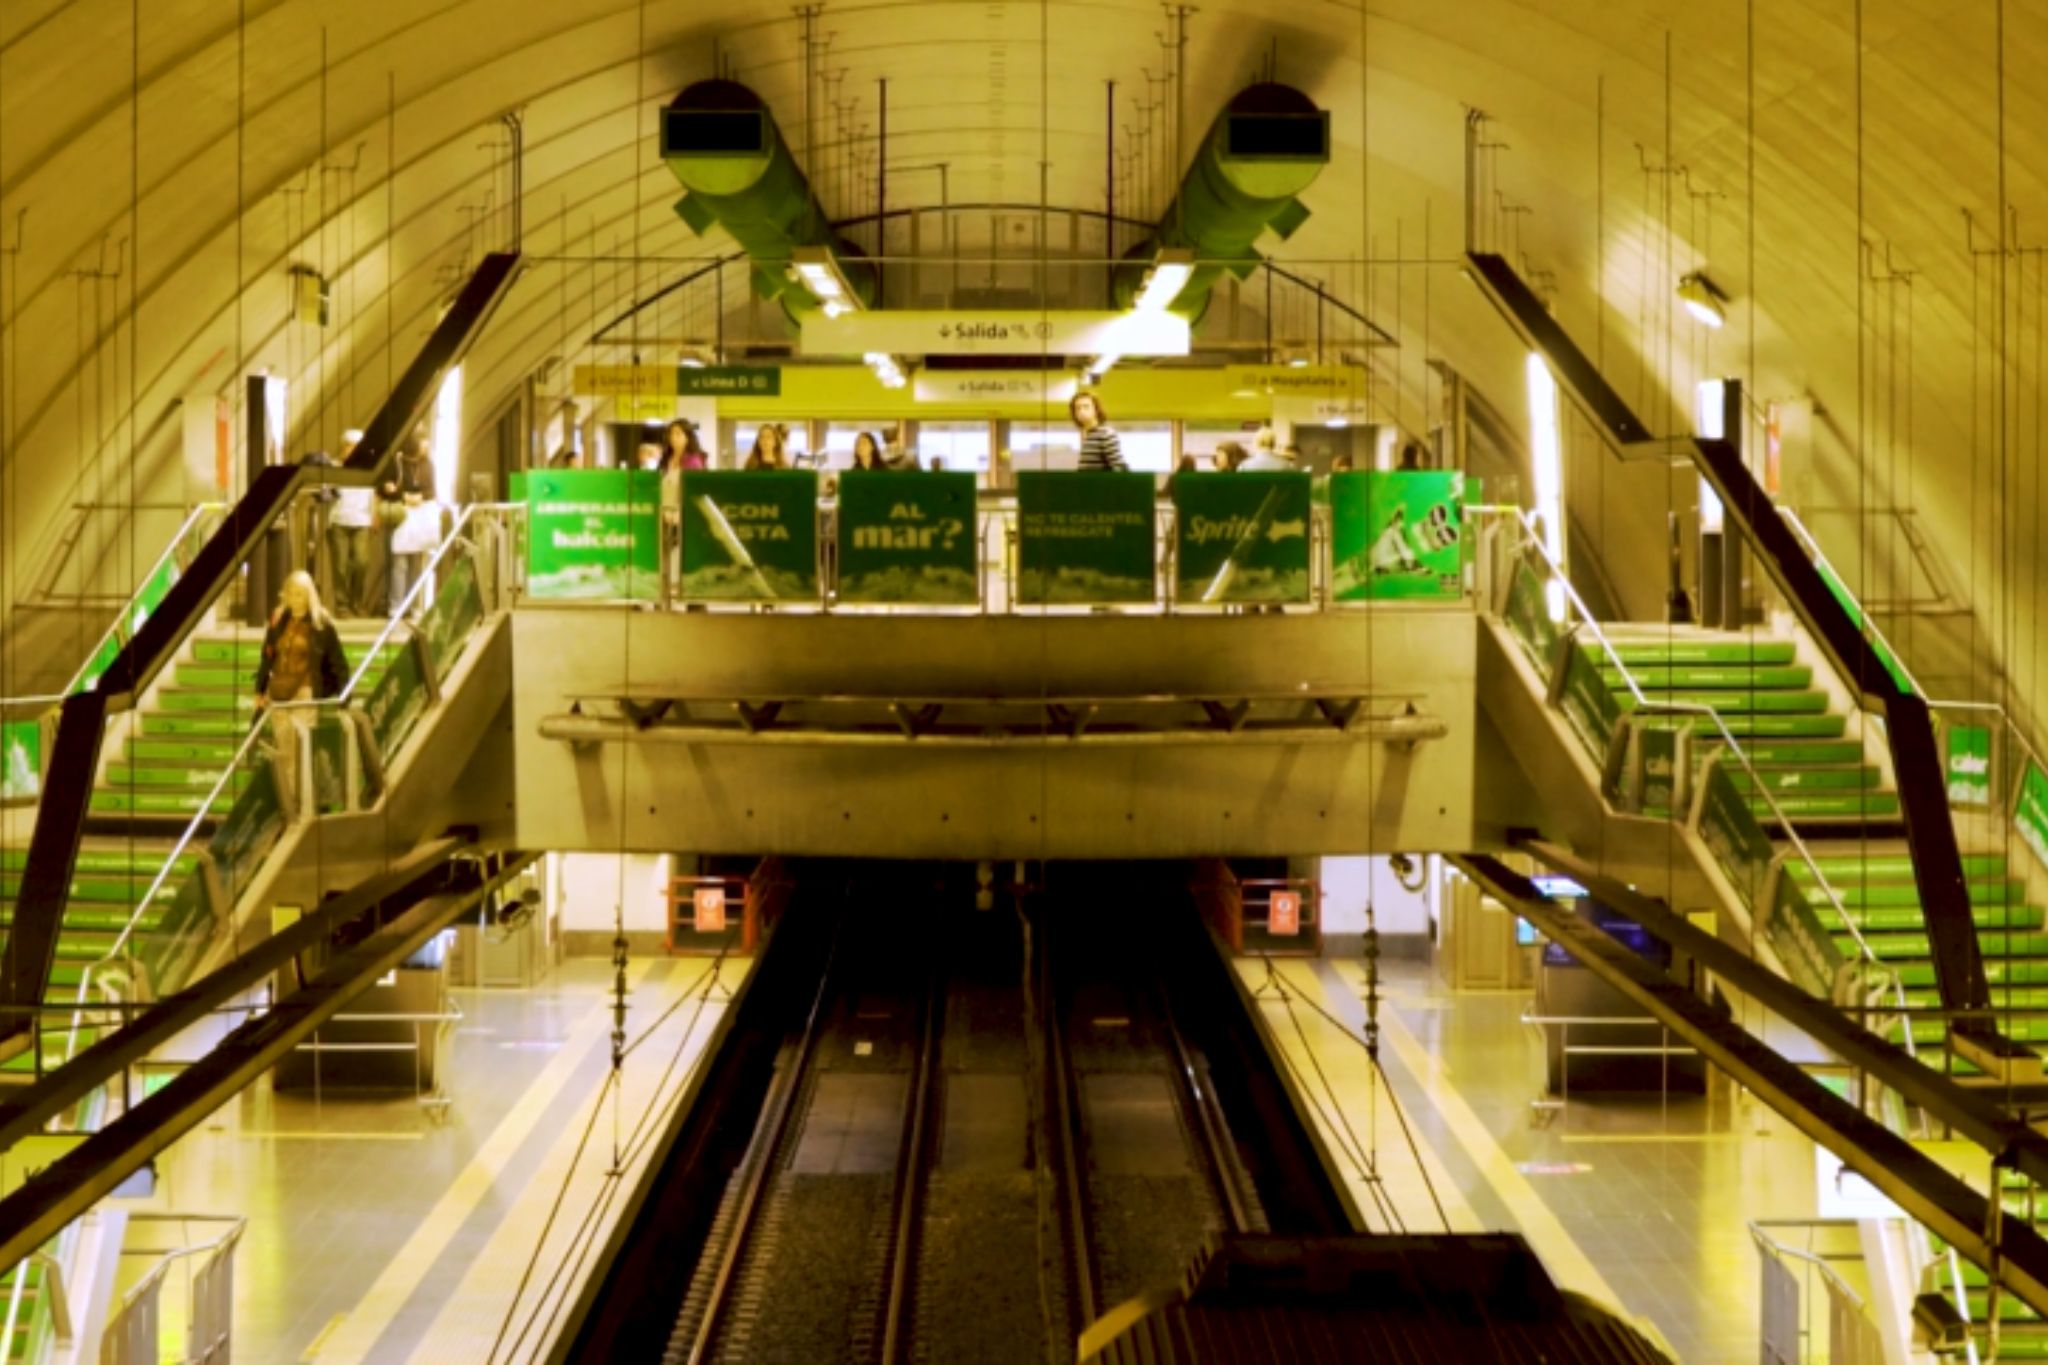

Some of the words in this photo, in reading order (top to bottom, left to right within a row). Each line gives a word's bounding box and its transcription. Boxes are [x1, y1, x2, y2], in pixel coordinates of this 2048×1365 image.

[956, 322, 1008, 339] Salida
[967, 380, 1005, 392] Salida
[721, 504, 780, 520] CON
[889, 502, 927, 518] AL
[1049, 512, 1065, 525] TE
[853, 517, 963, 550] mar?
[1185, 514, 1260, 547] Sprite
